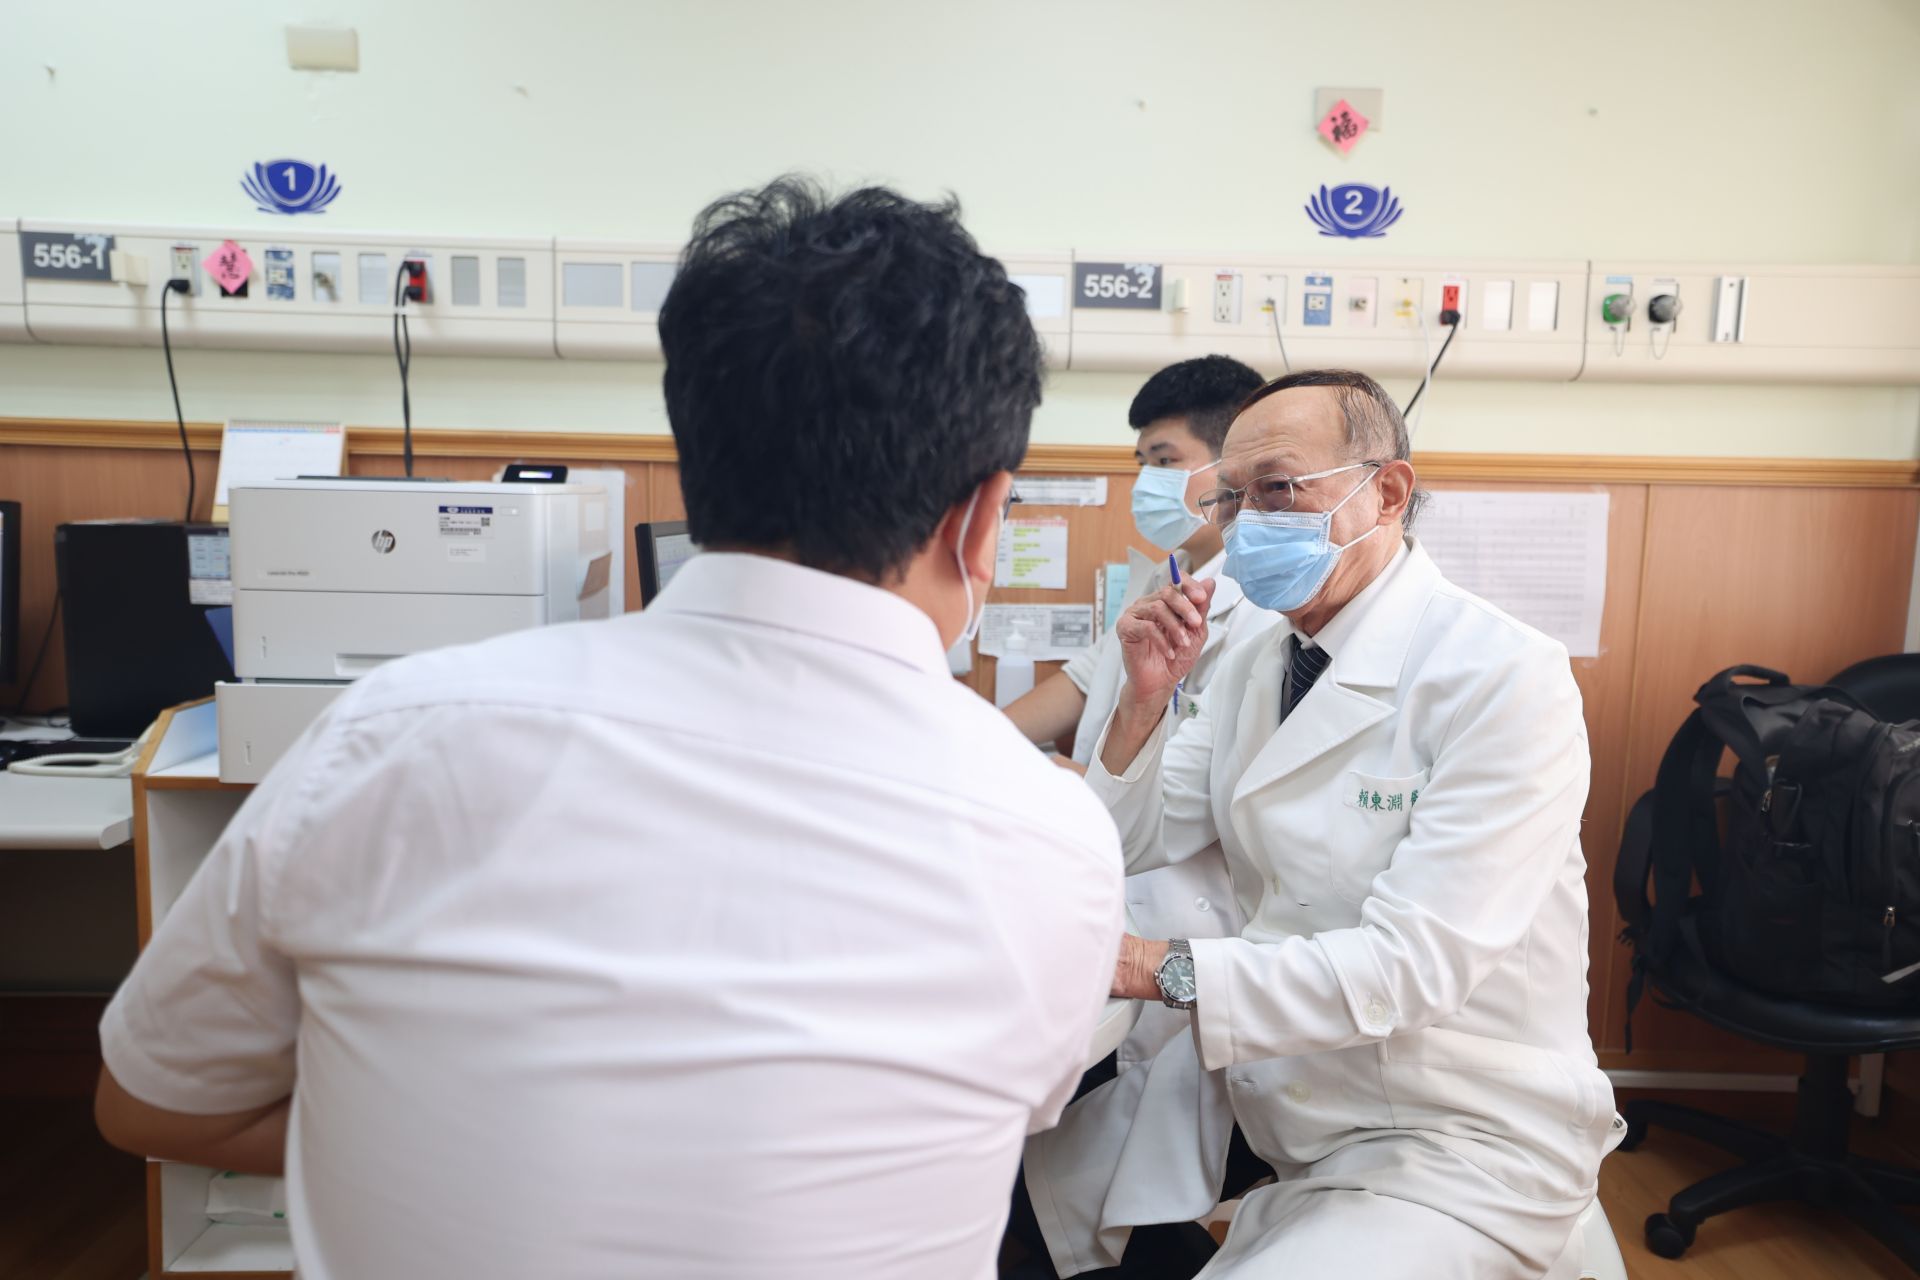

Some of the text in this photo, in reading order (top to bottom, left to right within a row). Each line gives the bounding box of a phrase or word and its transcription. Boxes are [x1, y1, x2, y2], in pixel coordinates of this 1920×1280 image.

[282, 165, 296, 192] 1
[1343, 189, 1363, 215] 2
[33, 242, 104, 270] 556-1
[1083, 273, 1153, 299] 556-2
[373, 529, 394, 555] hp
